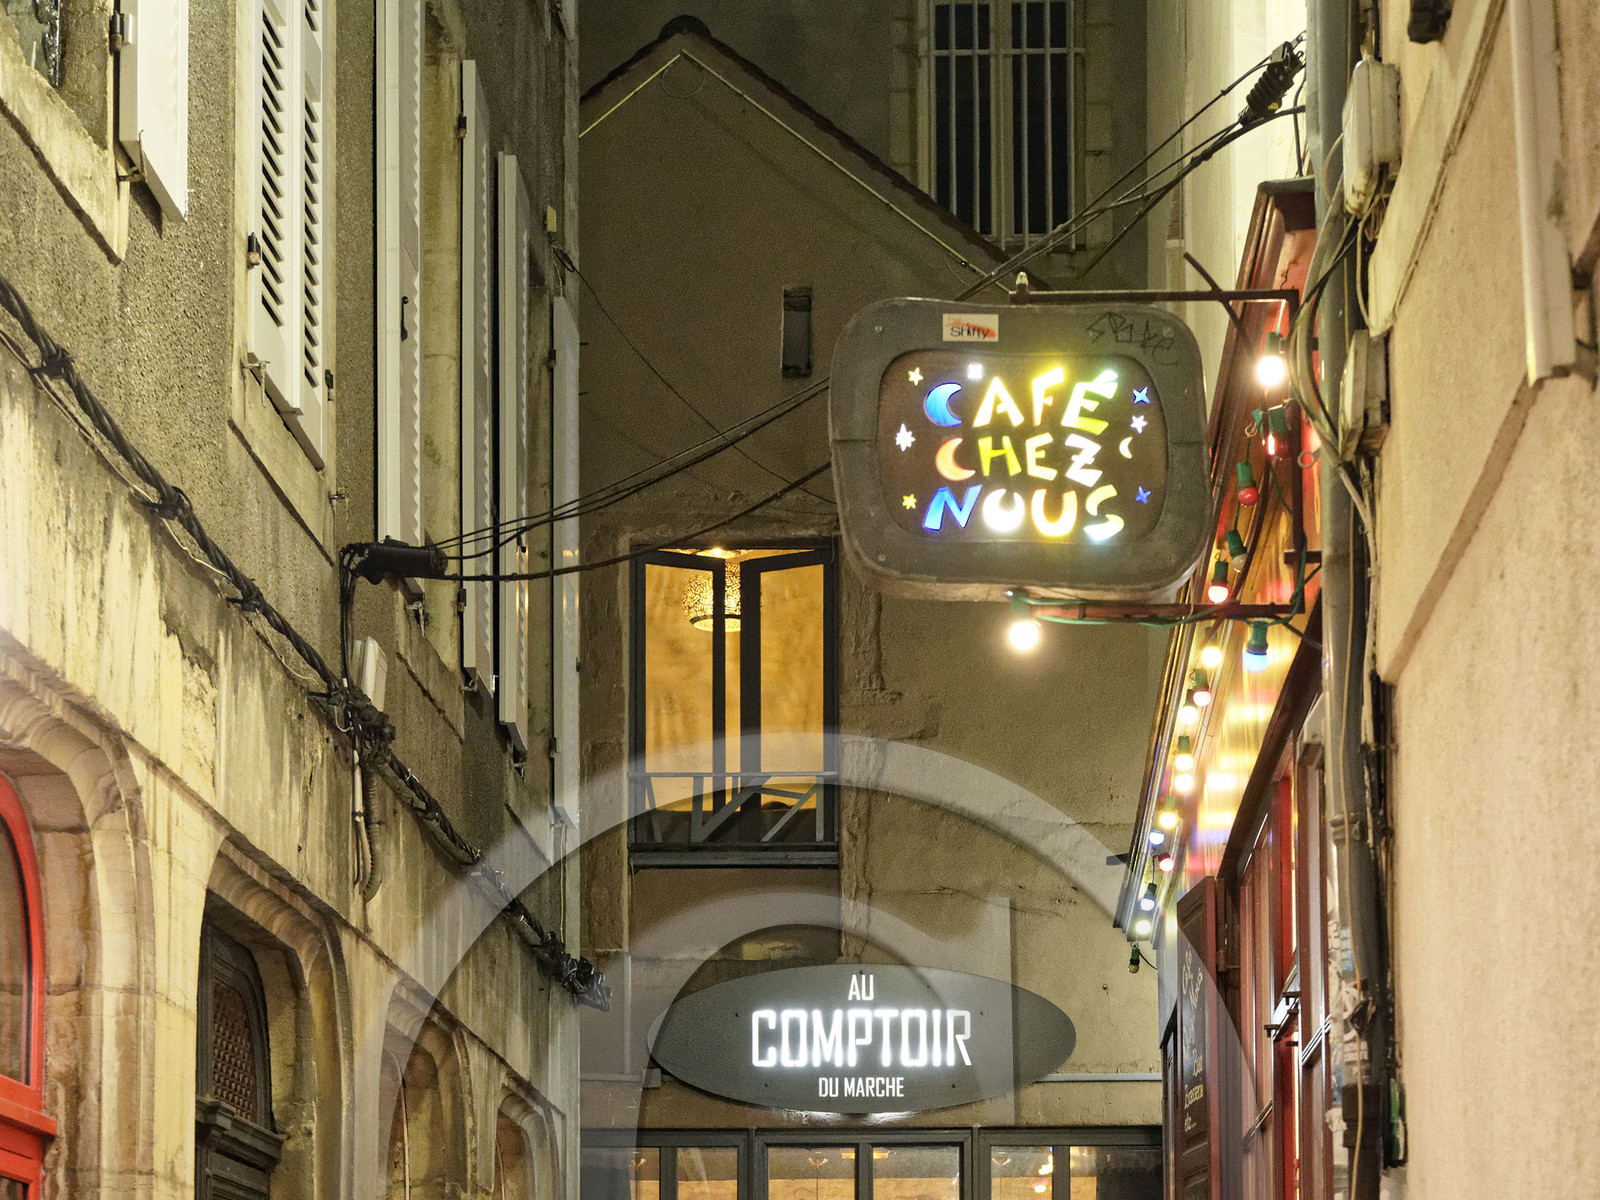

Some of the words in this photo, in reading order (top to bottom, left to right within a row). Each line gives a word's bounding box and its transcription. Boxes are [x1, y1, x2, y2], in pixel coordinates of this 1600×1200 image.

[935, 432, 1102, 488] CHEZ
[922, 483, 1125, 541] NOUS
[848, 974, 875, 1001] AU
[751, 1009, 972, 1068] COMPTOIR
[818, 1077, 839, 1098] DU
[844, 1077, 905, 1098] MARCHE
